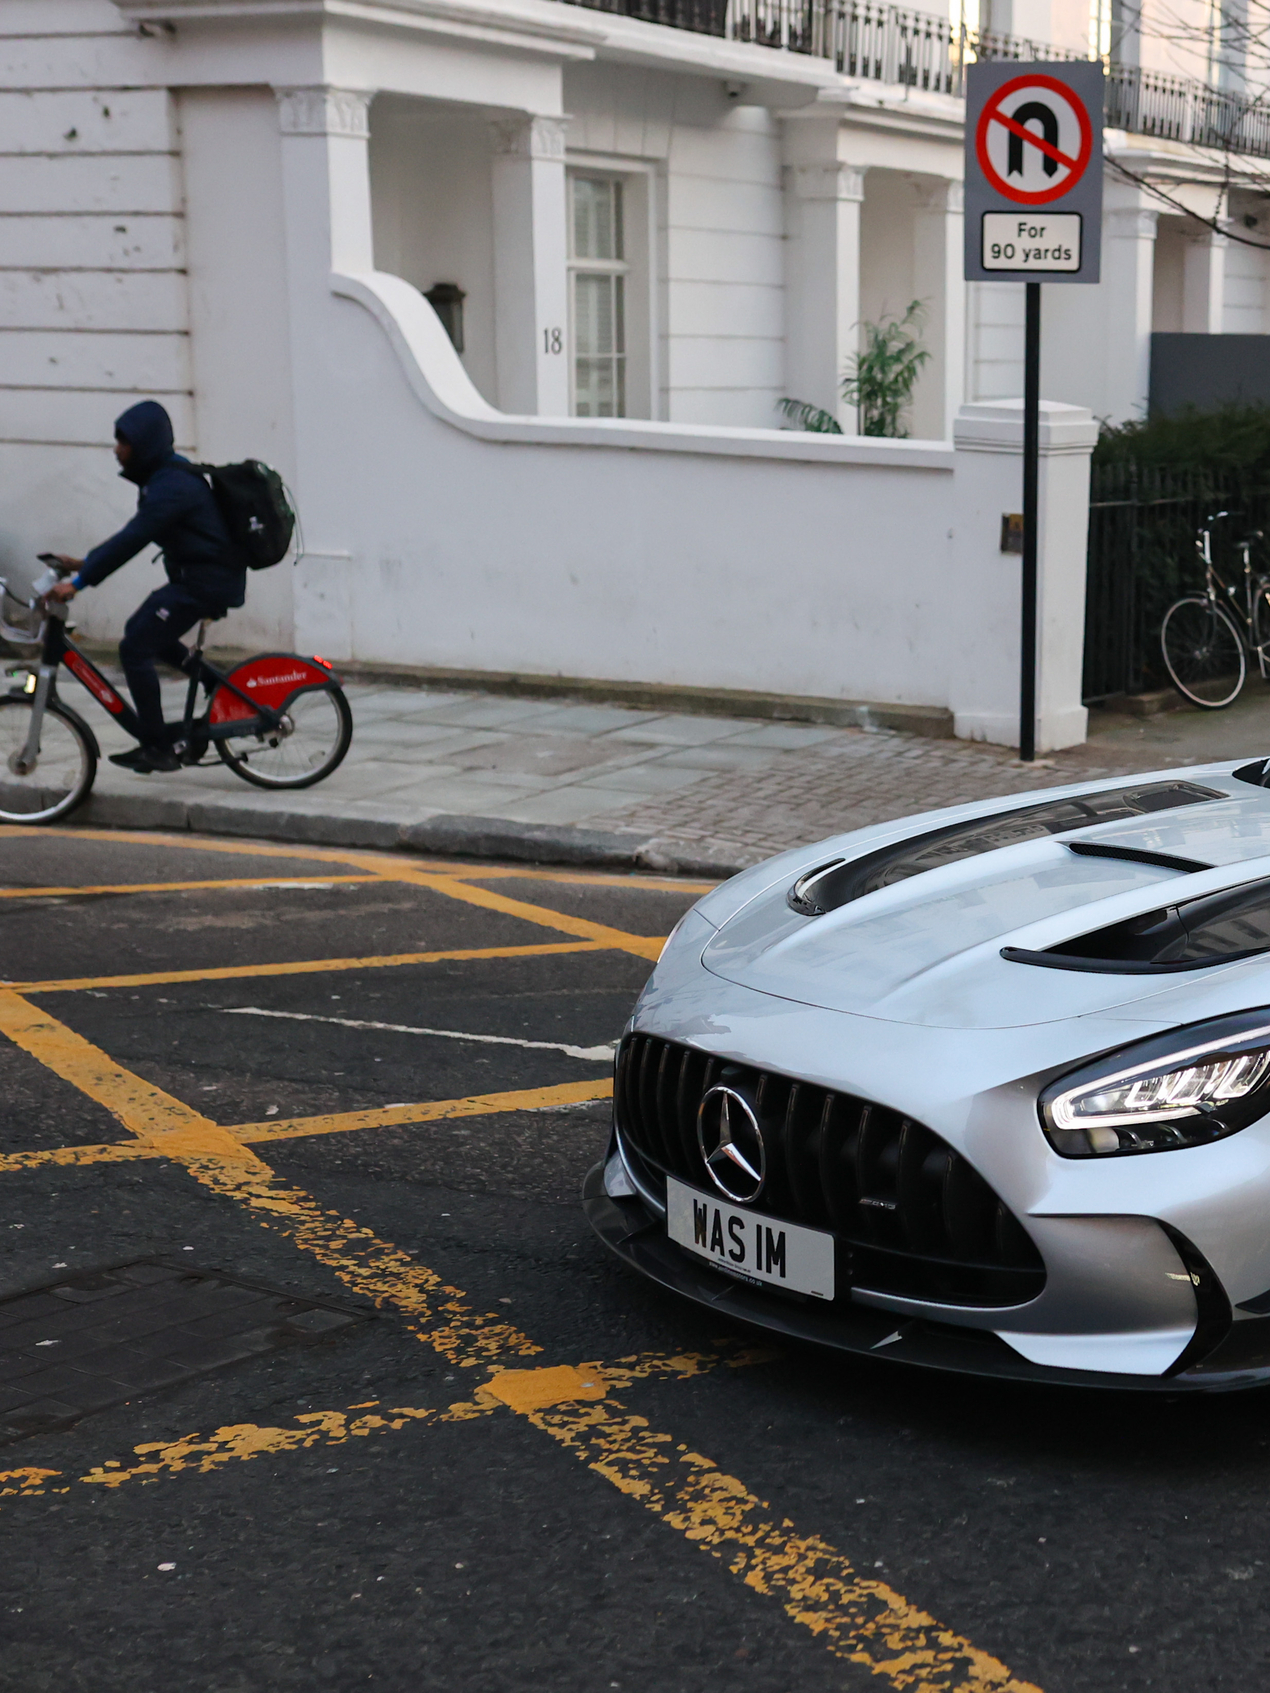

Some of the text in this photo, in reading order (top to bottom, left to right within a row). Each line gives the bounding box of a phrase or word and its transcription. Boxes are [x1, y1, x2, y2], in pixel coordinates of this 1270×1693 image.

[1017, 222, 1047, 238] For
[990, 243, 1072, 263] 90 yards
[543, 327, 562, 356] 18
[257, 669, 307, 686] Santander
[693, 1198, 746, 1263] WAS
